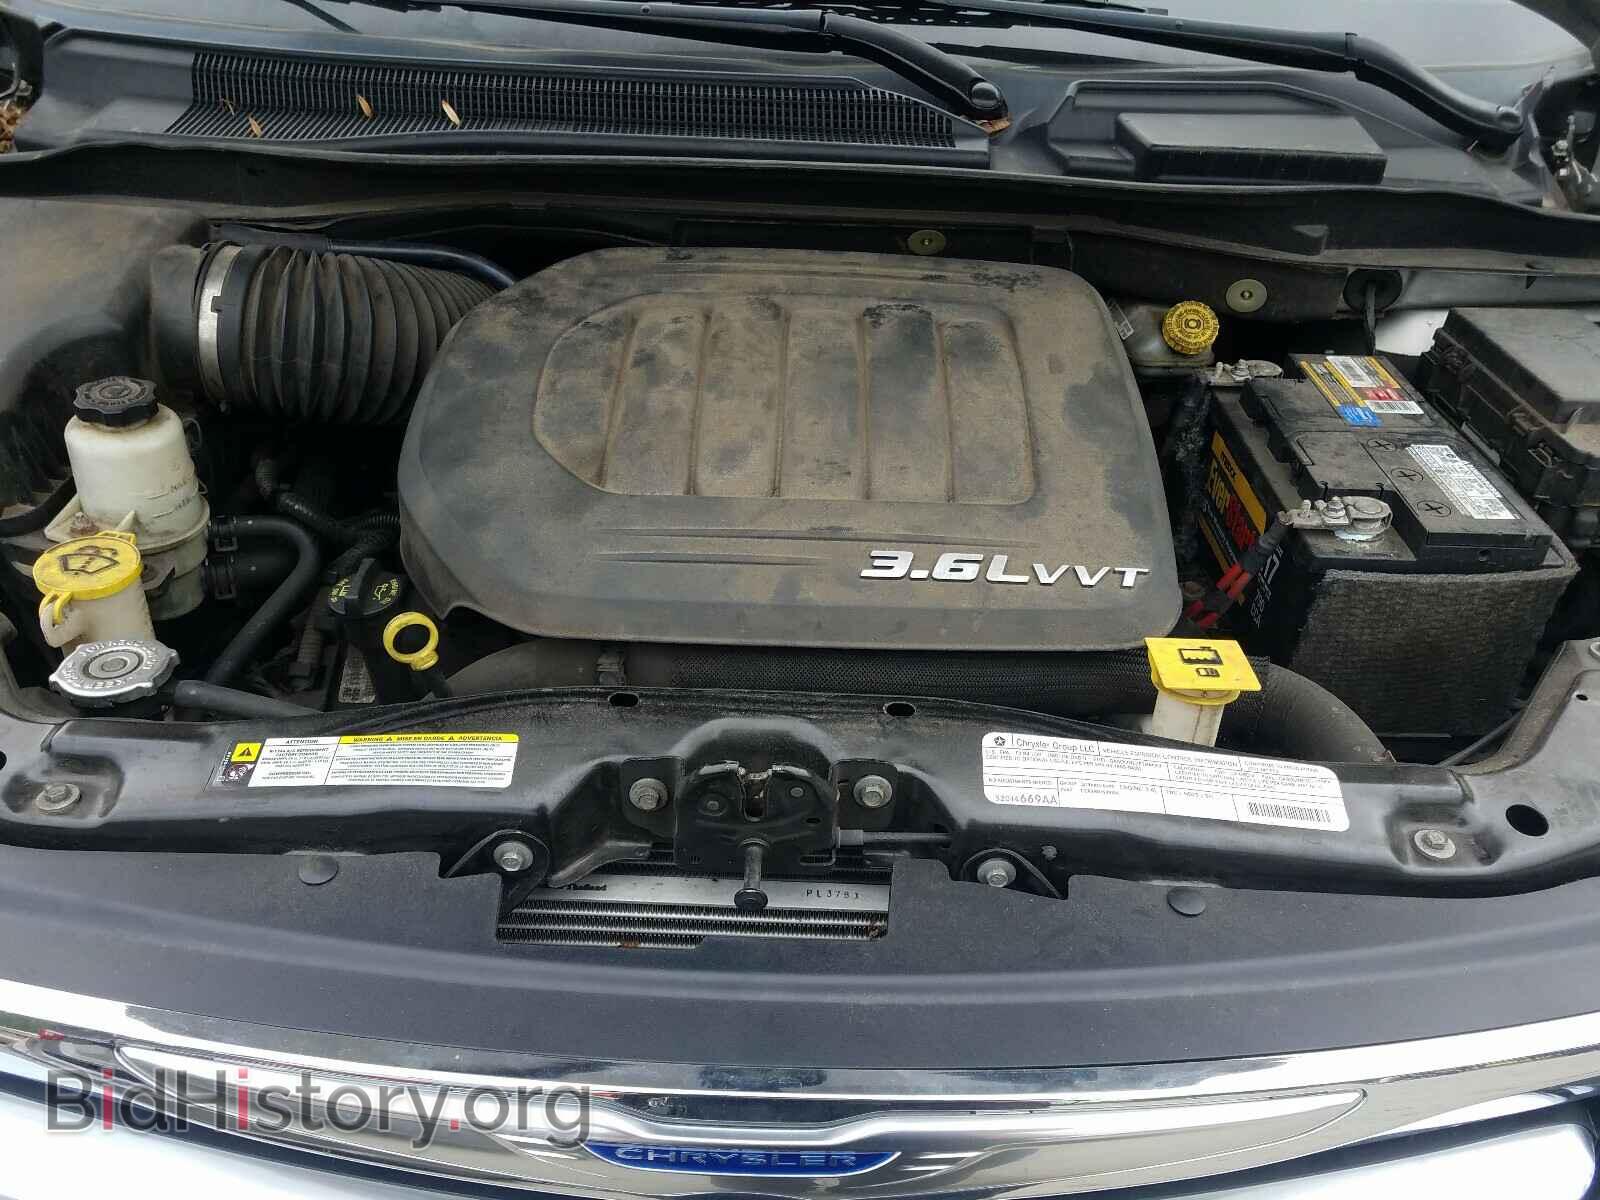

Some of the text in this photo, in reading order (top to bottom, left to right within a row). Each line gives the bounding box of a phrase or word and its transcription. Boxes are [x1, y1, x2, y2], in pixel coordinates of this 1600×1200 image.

[860, 550, 1151, 588] 3.6L VVT
[1016, 737, 1096, 754] Chrysler Group LLC
[615, 1146, 857, 1168] CHRYSLER
